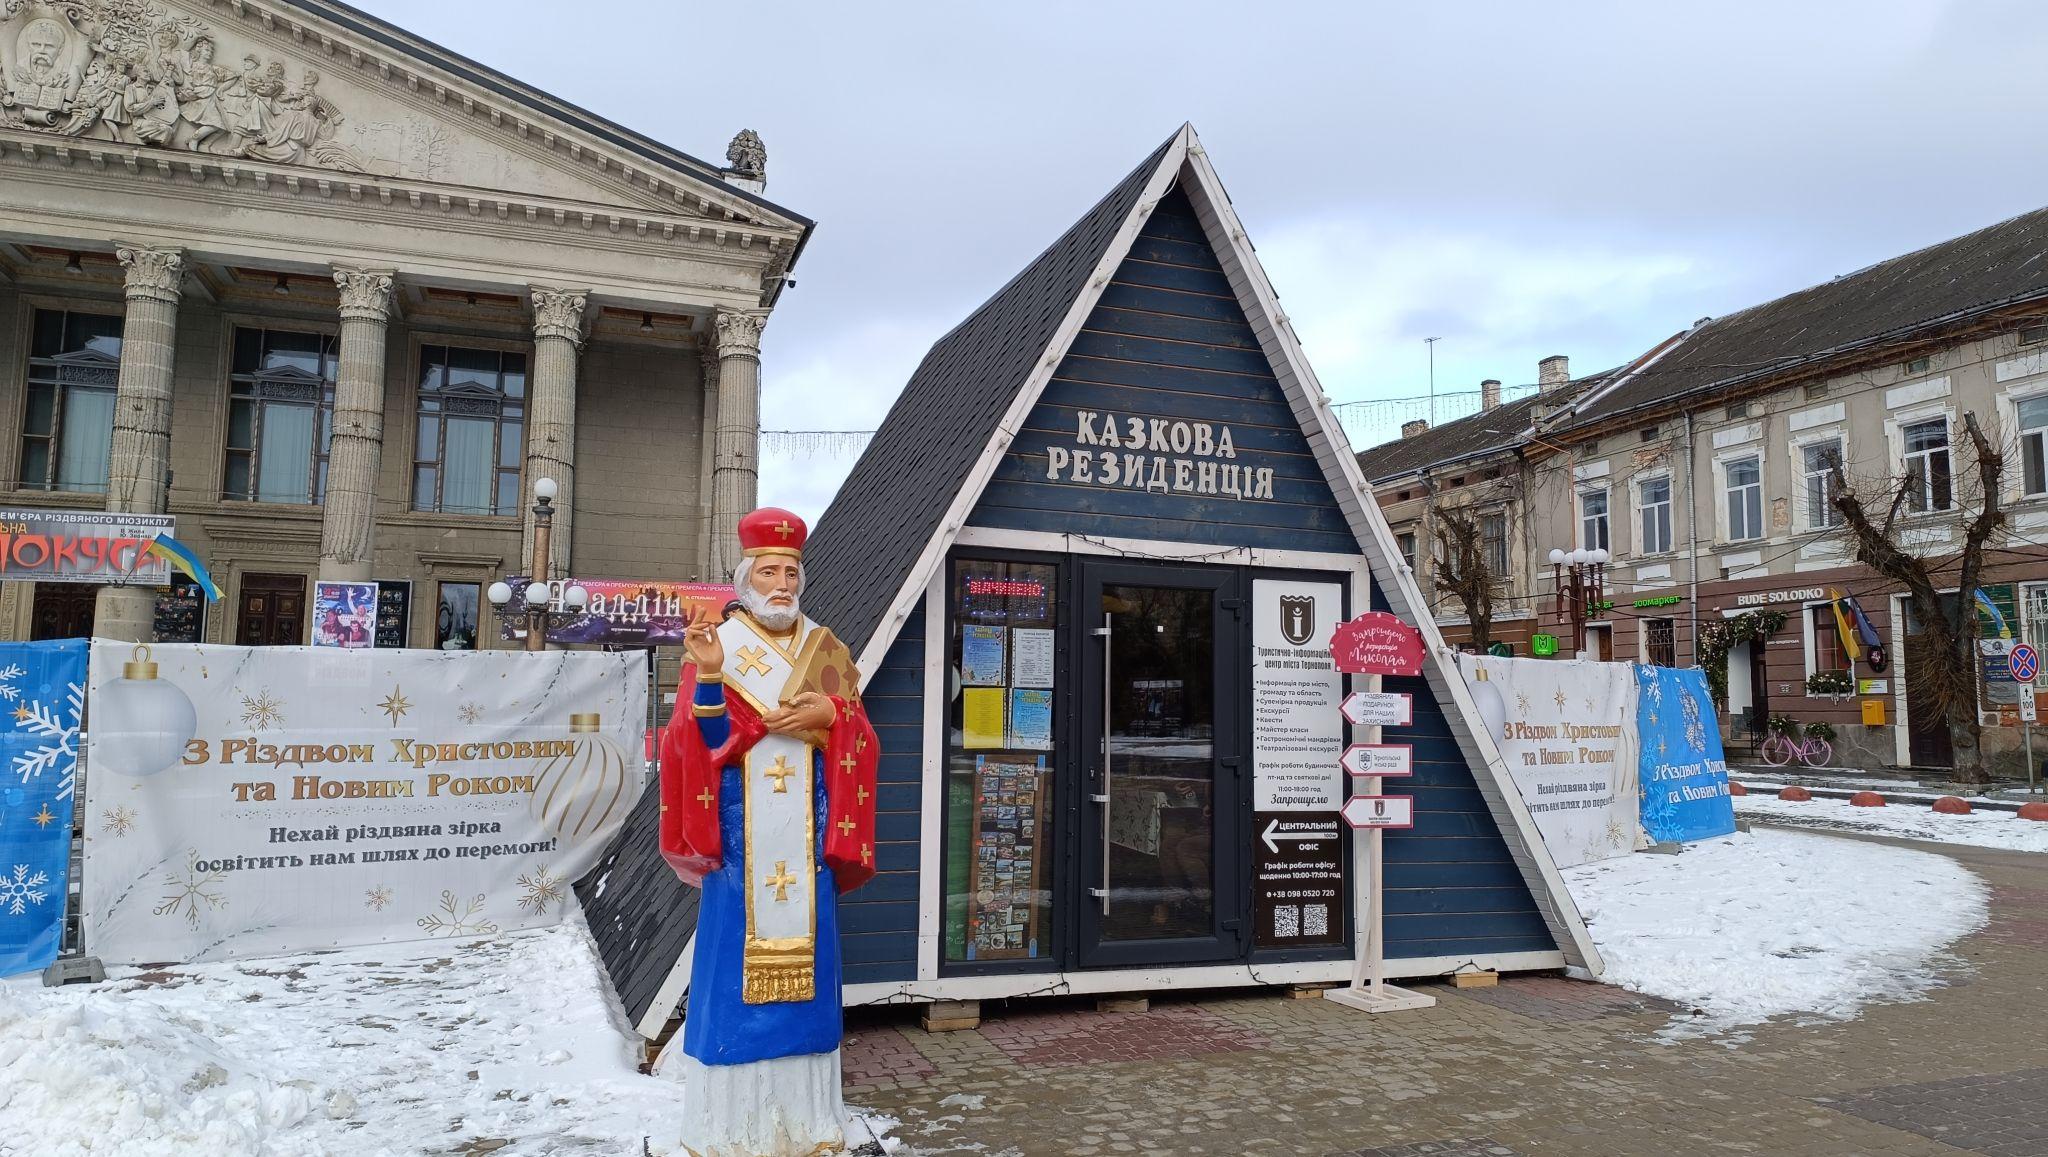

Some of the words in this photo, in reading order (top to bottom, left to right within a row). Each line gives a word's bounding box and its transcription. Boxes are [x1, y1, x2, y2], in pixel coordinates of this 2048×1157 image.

[1076, 410, 1236, 458] КАЗКОВА
[1046, 446, 1274, 500] РЕЗИДЕНЦІЯ
[46, 514, 113, 524] РІЗДВЯНОГО
[117, 516, 169, 526] МЮЗИКЛУ
[970, 581, 1041, 596] ВІДЧИНЕНО
[1738, 594, 1768, 605] BUDE
[1769, 588, 1824, 602] SOLODKO
[547, 578, 681, 624] Ааддін
[1633, 596, 1680, 608] зоомаркет
[1348, 647, 1408, 666] Миколая
[1265, 661, 1281, 670] центр
[1283, 661, 1300, 669] міста
[2022, 701, 2033, 709] 100
[1504, 722, 1513, 740] З
[1515, 721, 1557, 743] Різдвом
[182, 738, 210, 766] З
[220, 737, 374, 770] Різдвом
[388, 736, 576, 769] Христовим
[1522, 752, 1537, 766] та
[1540, 748, 1574, 765] Новим
[1653, 765, 1660, 781] З
[1661, 763, 1701, 781] Різдвом
[231, 780, 276, 802] та
[292, 775, 413, 801] Новим
[428, 773, 536, 797] Роком
[1590, 781, 1606, 793] зірка
[1668, 791, 1682, 804] та
[1682, 785, 1718, 801] Новим
[1271, 794, 1329, 807] Запрошуємо
[1560, 801, 1580, 810] шлях
[1582, 800, 1591, 810] до
[269, 824, 340, 844] Нехай
[346, 821, 442, 843] різдвяна
[448, 820, 502, 838] зірка
[1279, 821, 1337, 830] ЦЕНТРАЛЬНИЙ
[195, 854, 303, 874] освітить
[310, 851, 355, 867] нам
[361, 848, 418, 865] шлях
[423, 847, 451, 861] до
[455, 837, 558, 860] перемоги!
[1299, 843, 1319, 851] ОФІС
[1289, 862, 1314, 870] роботи
[1315, 862, 1336, 870] офісу:
